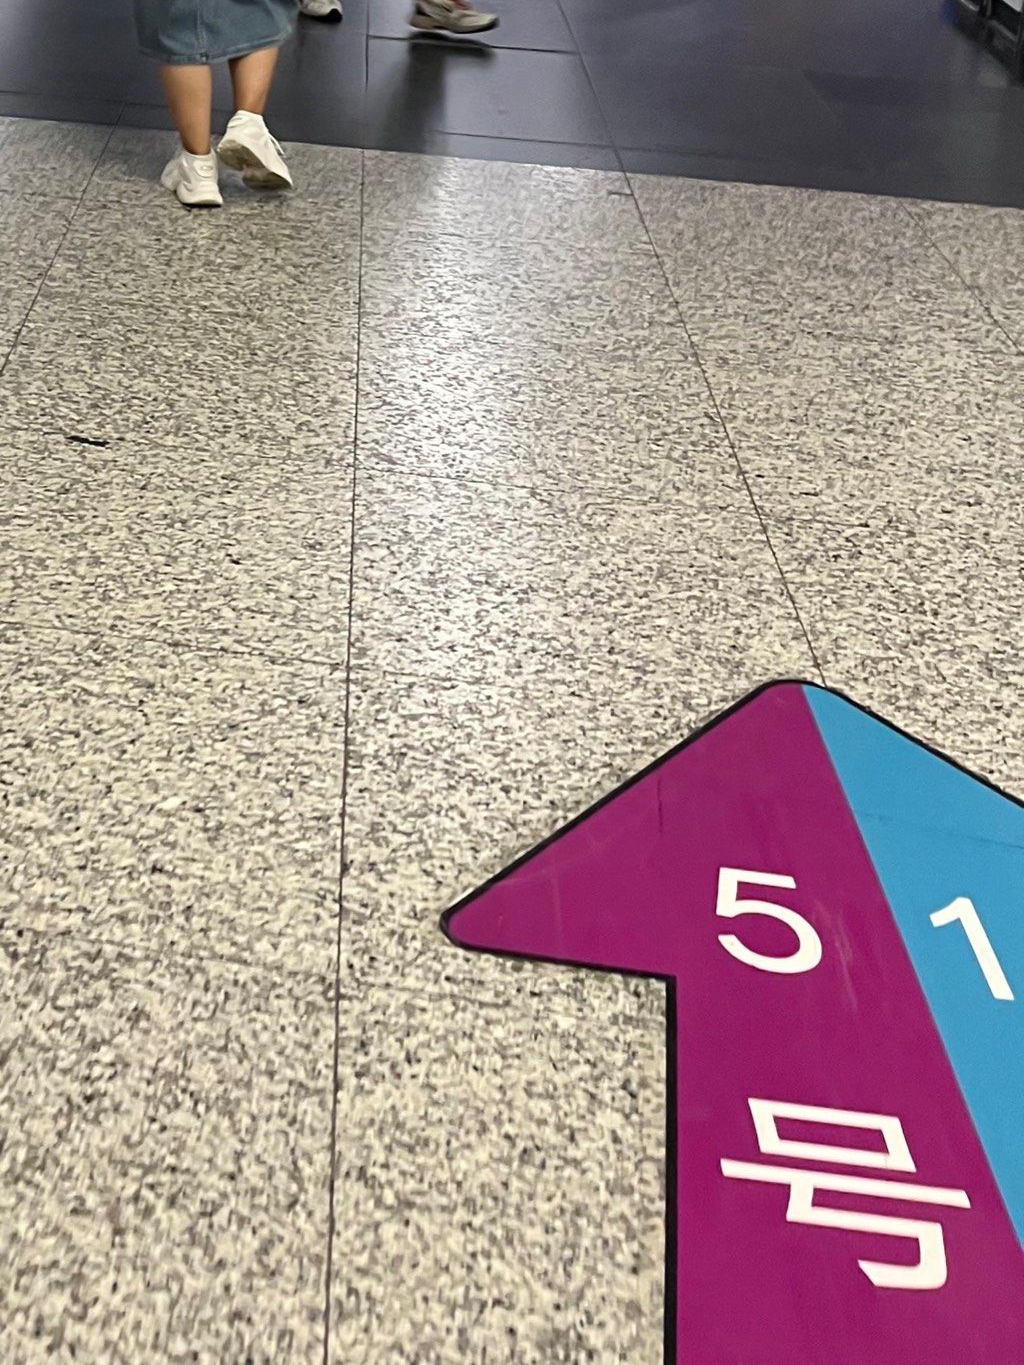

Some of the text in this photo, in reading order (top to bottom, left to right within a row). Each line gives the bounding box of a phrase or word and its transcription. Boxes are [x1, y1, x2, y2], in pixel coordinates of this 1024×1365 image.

[715, 866, 971, 1290] 5 号
[928, 895, 1015, 1001] 1
